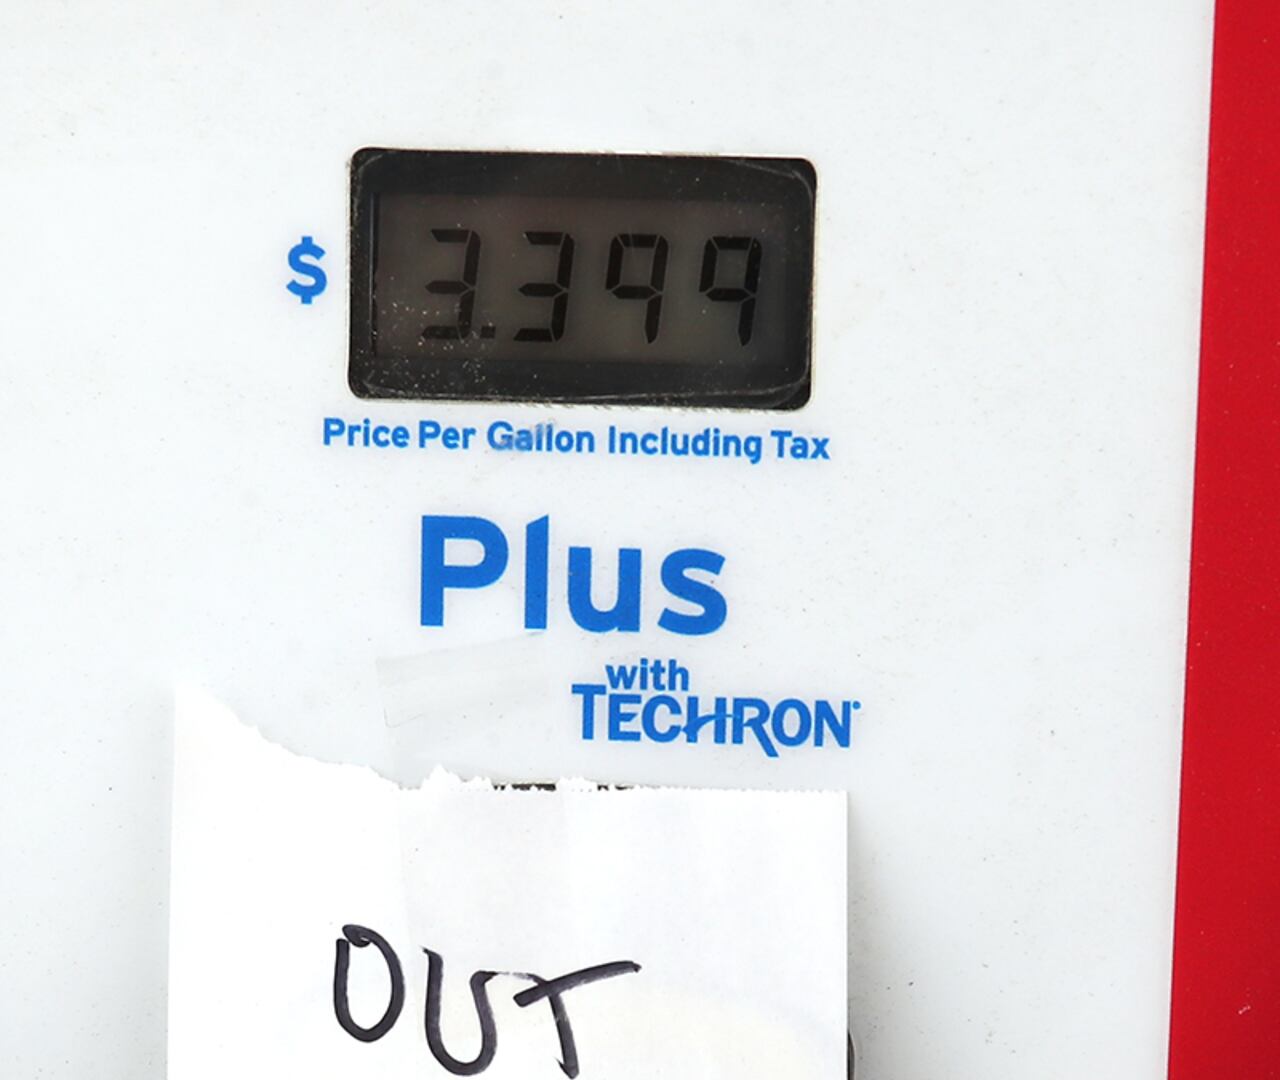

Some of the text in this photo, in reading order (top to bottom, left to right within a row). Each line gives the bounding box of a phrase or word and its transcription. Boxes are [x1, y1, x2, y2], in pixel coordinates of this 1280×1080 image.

[286, 234, 329, 306] $
[419, 228, 763, 346] 3.399
[322, 416, 831, 466] Price Per Gallon Including Tax
[419, 513, 729, 638] Plus
[605, 658, 691, 692] with
[333, 924, 642, 1080] OUT
